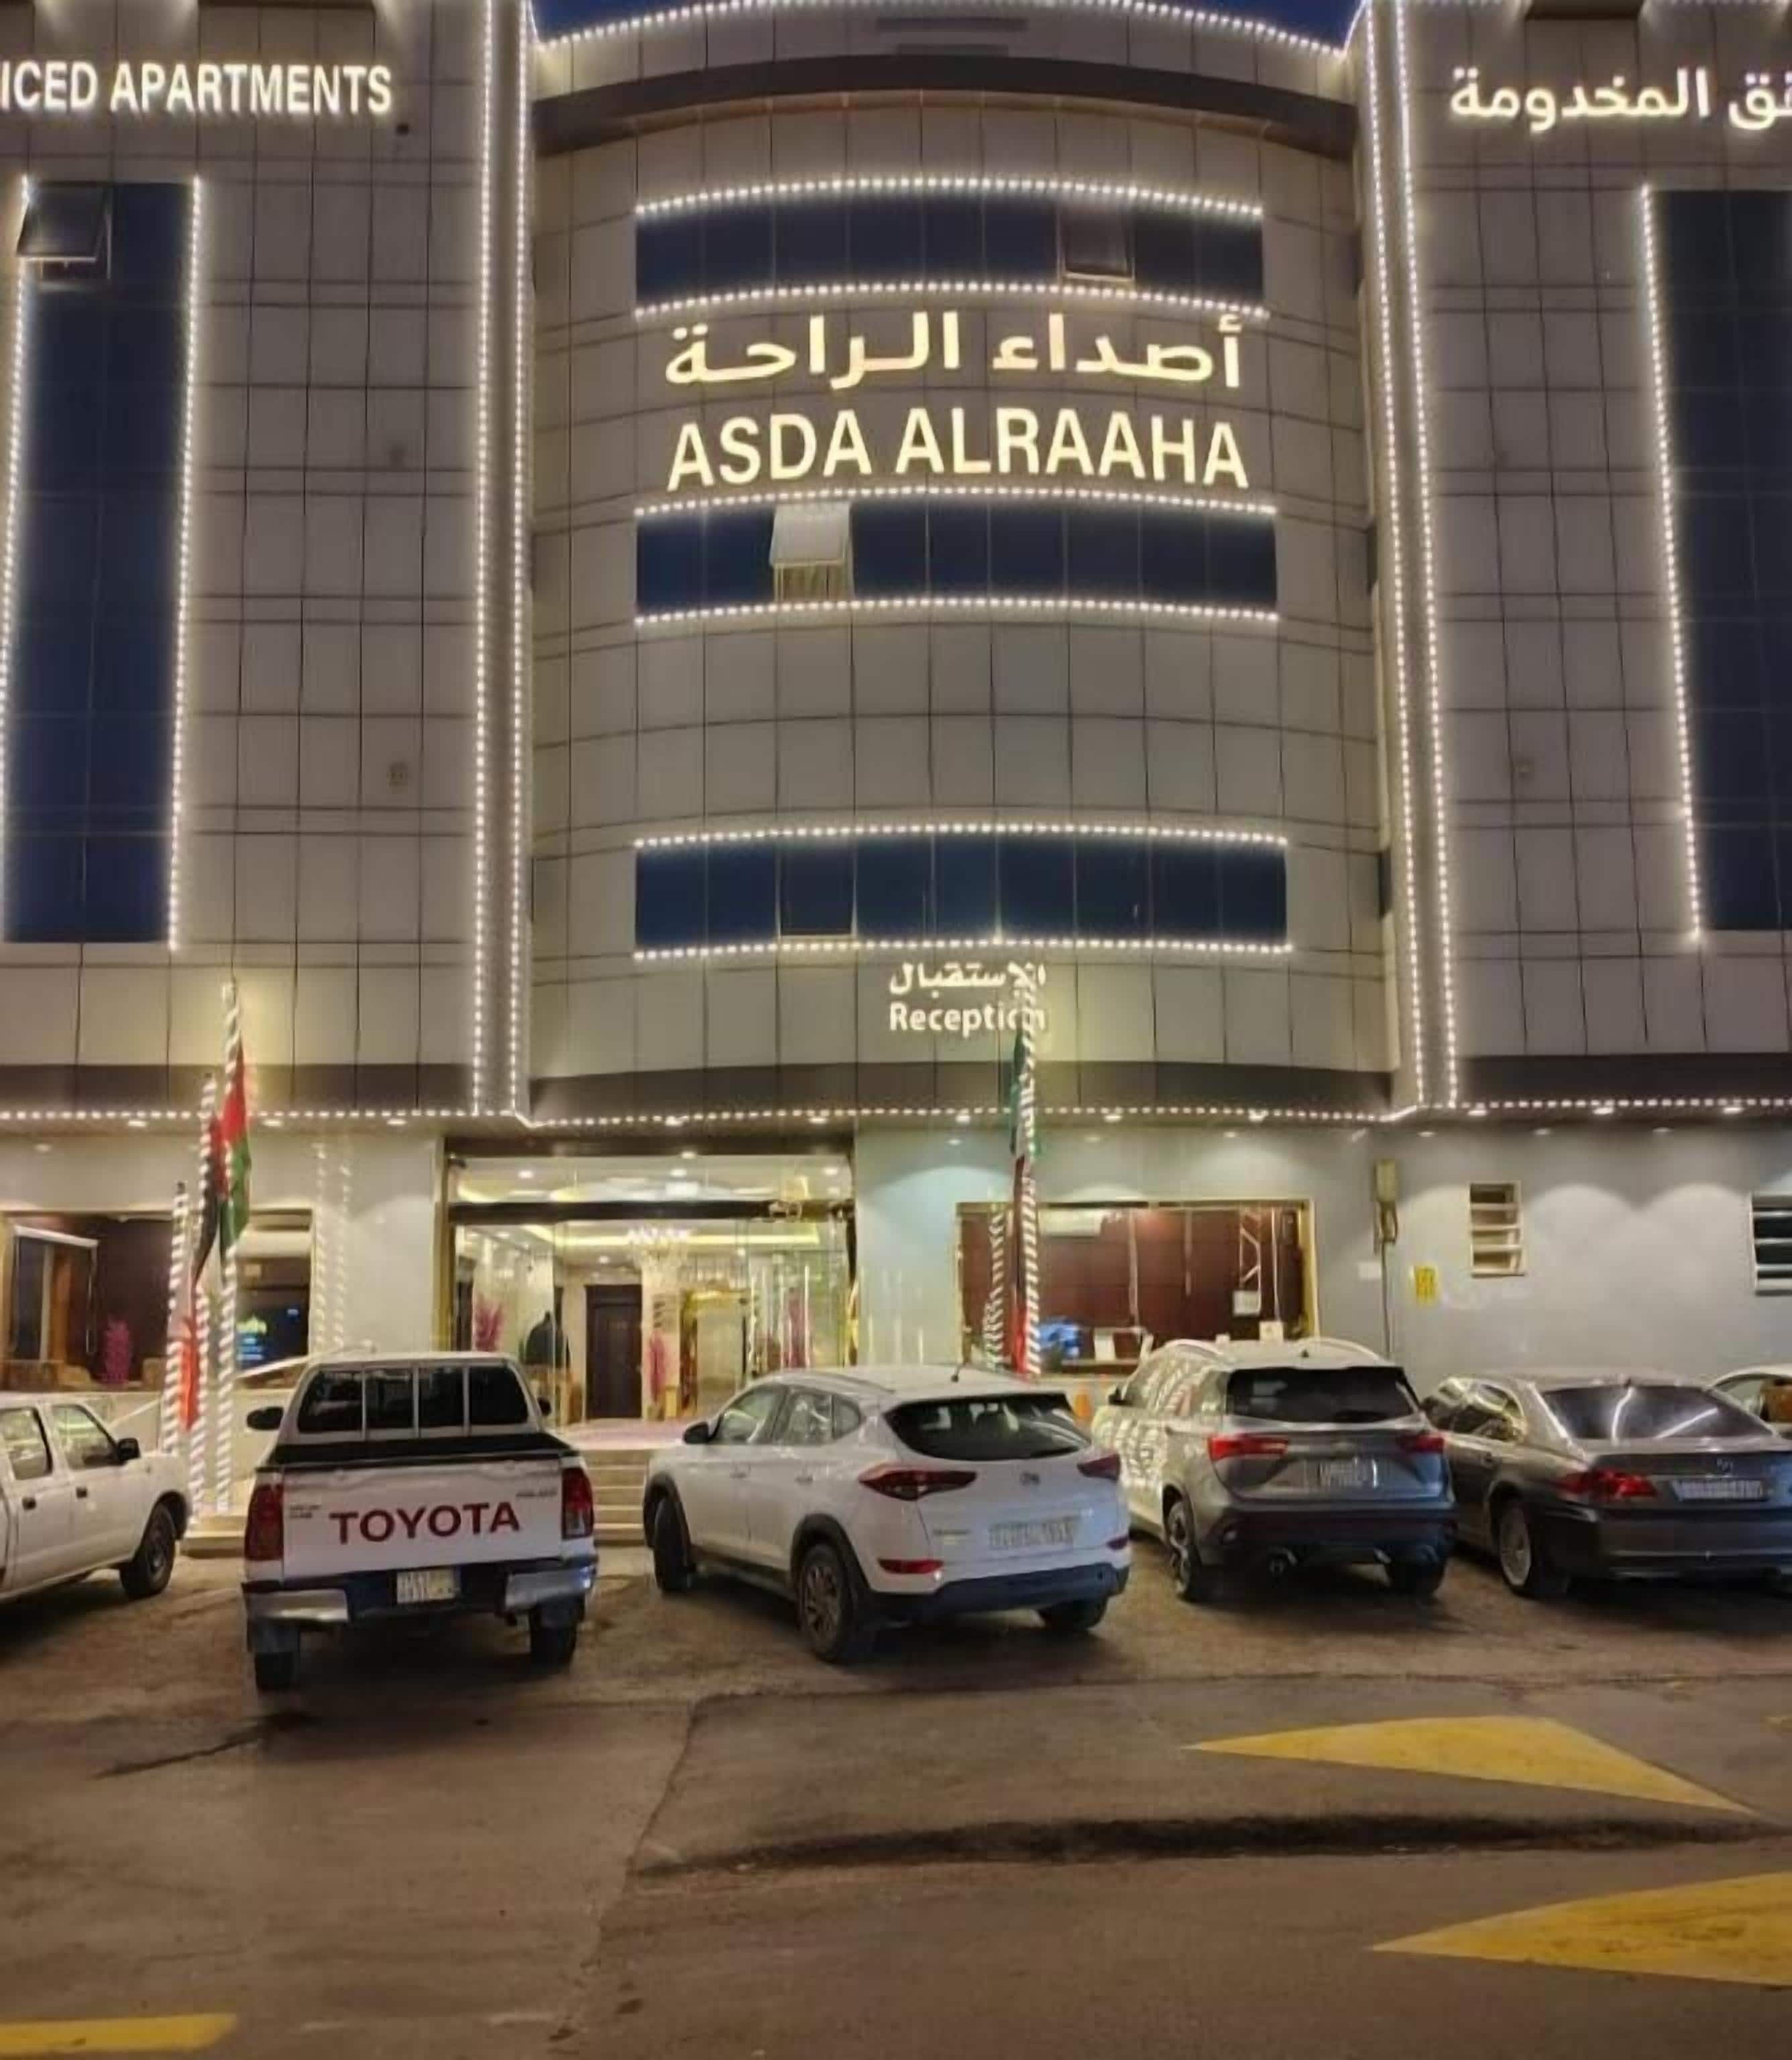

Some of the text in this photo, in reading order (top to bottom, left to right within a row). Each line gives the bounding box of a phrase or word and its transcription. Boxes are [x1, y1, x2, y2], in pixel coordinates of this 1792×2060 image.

[0, 61, 392, 113] ICED APARTMENTS
[1450, 67, 1710, 133] المخدومة
[665, 311, 1243, 390] أصداء الراحة
[667, 408, 1249, 491] ASDA ALRAAHA
[329, 1502, 520, 1544] TOYOTA
